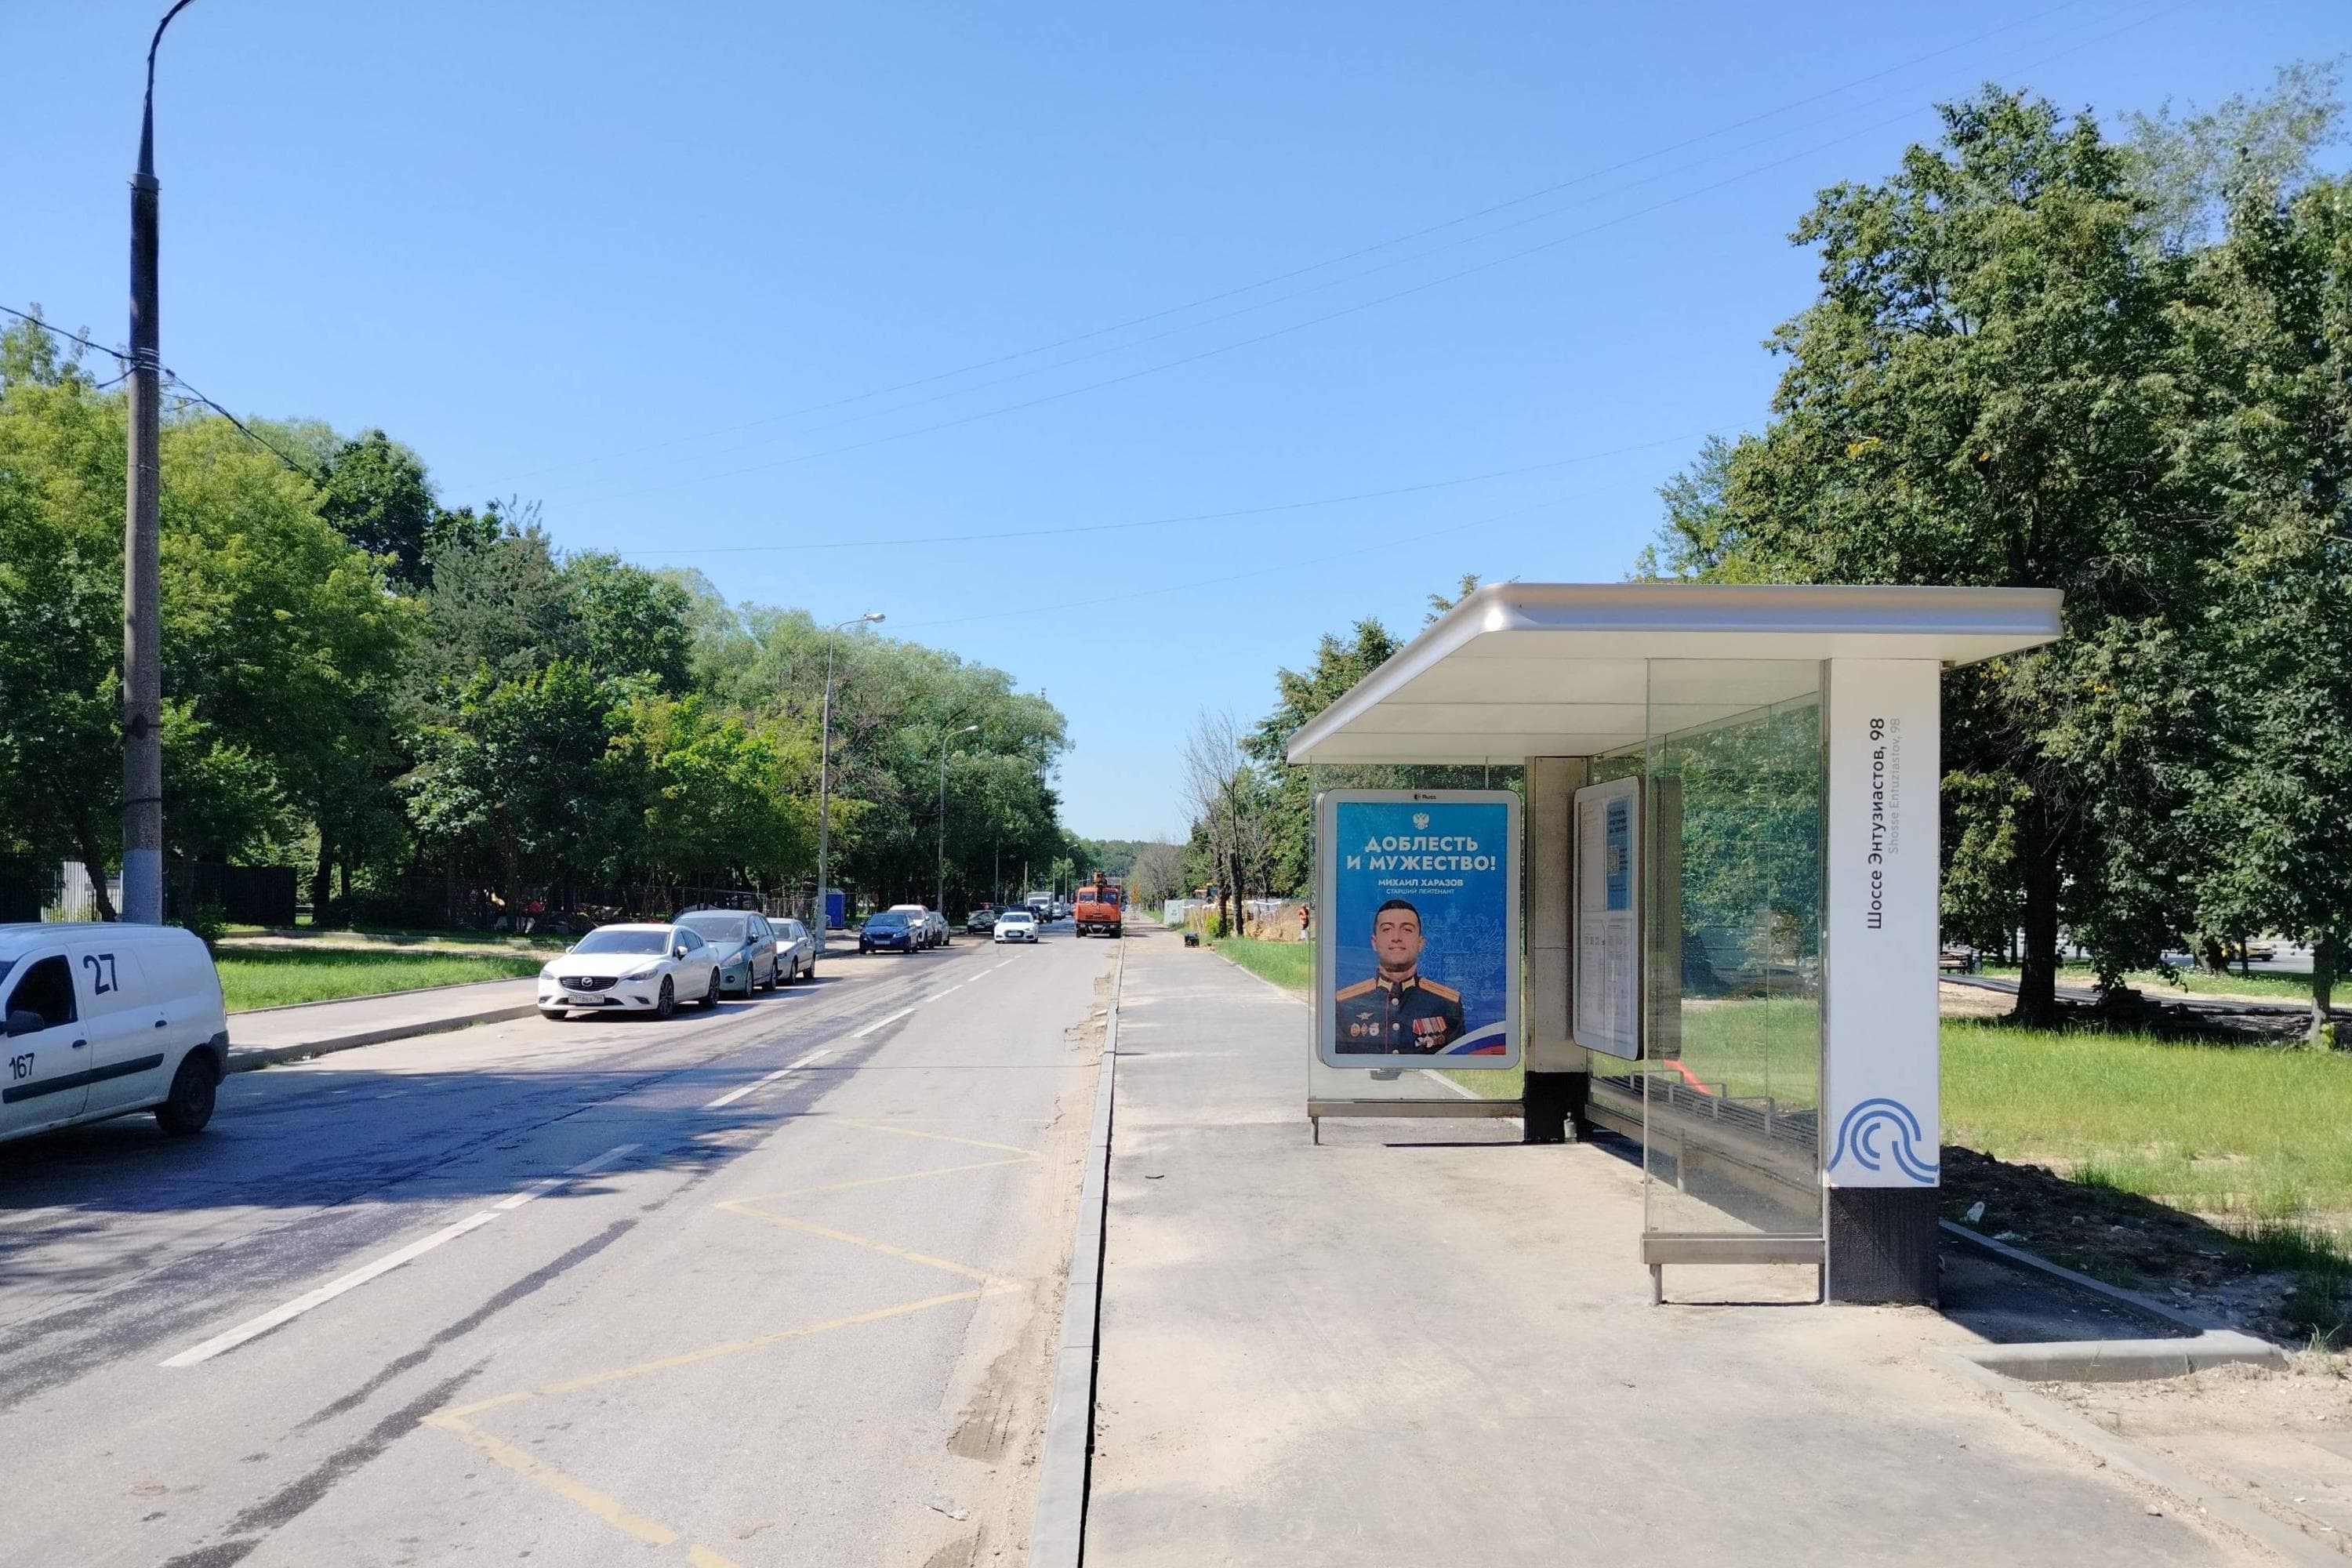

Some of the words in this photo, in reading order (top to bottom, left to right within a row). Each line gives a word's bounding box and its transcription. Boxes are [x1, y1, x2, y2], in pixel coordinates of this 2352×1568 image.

[1869, 717, 1885, 741] 98
[1889, 717, 1901, 734] 98
[1867, 746, 1887, 865] Энтузиастов,
[1365, 836, 1479, 853] ДОБЛЕСТЬ
[1888, 812, 1900, 854] Shosse
[1346, 855, 1361, 870] И
[1369, 855, 1496, 871] МУЖЕСТВО!
[1377, 878, 1418, 887] МИХАИЛ
[1421, 878, 1464, 887] ХАРАЗОВ
[1867, 869, 1882, 929] Шоссе
[82, 953, 118, 996] 27
[9, 1052, 35, 1080] 167
